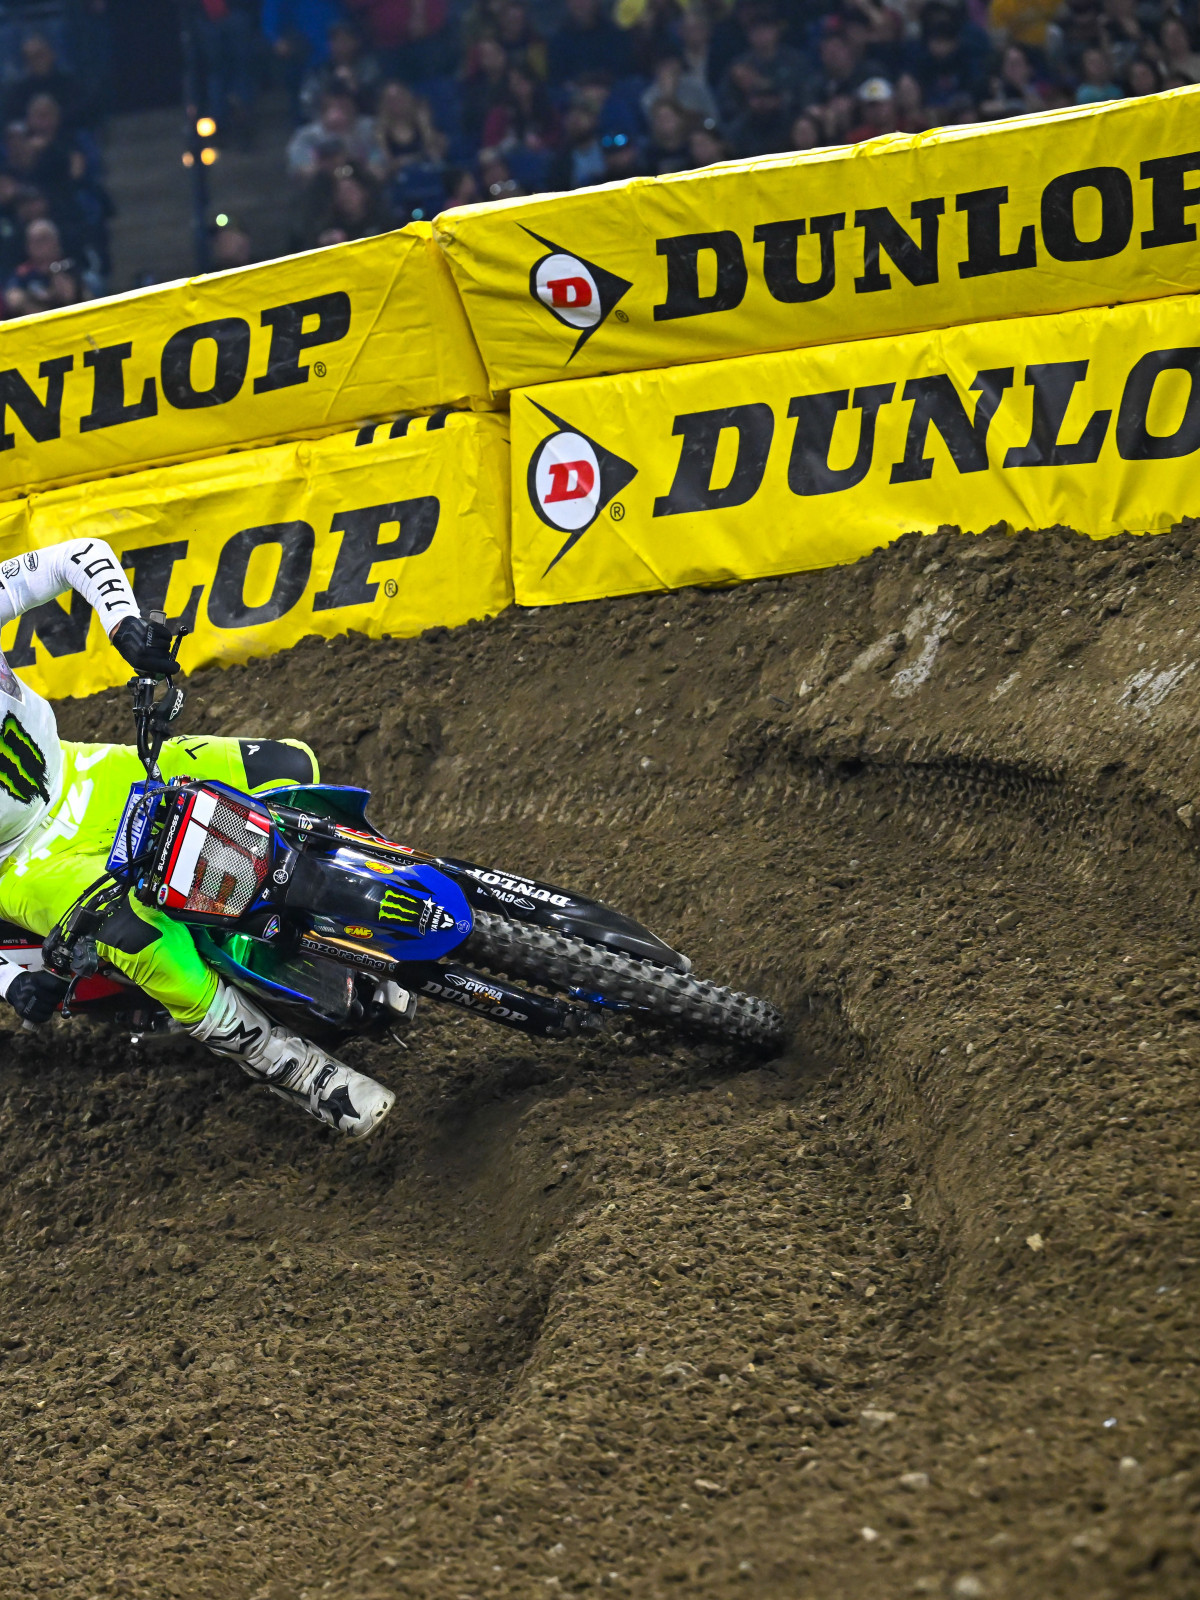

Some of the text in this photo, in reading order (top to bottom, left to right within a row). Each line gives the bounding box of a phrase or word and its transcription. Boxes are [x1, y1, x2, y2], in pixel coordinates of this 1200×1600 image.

[431, 905, 445, 932] YAMAHA
[344, 926, 374, 939] FMF
[338, 948, 386, 972] racing
[420, 980, 529, 1023] DUNLOP
